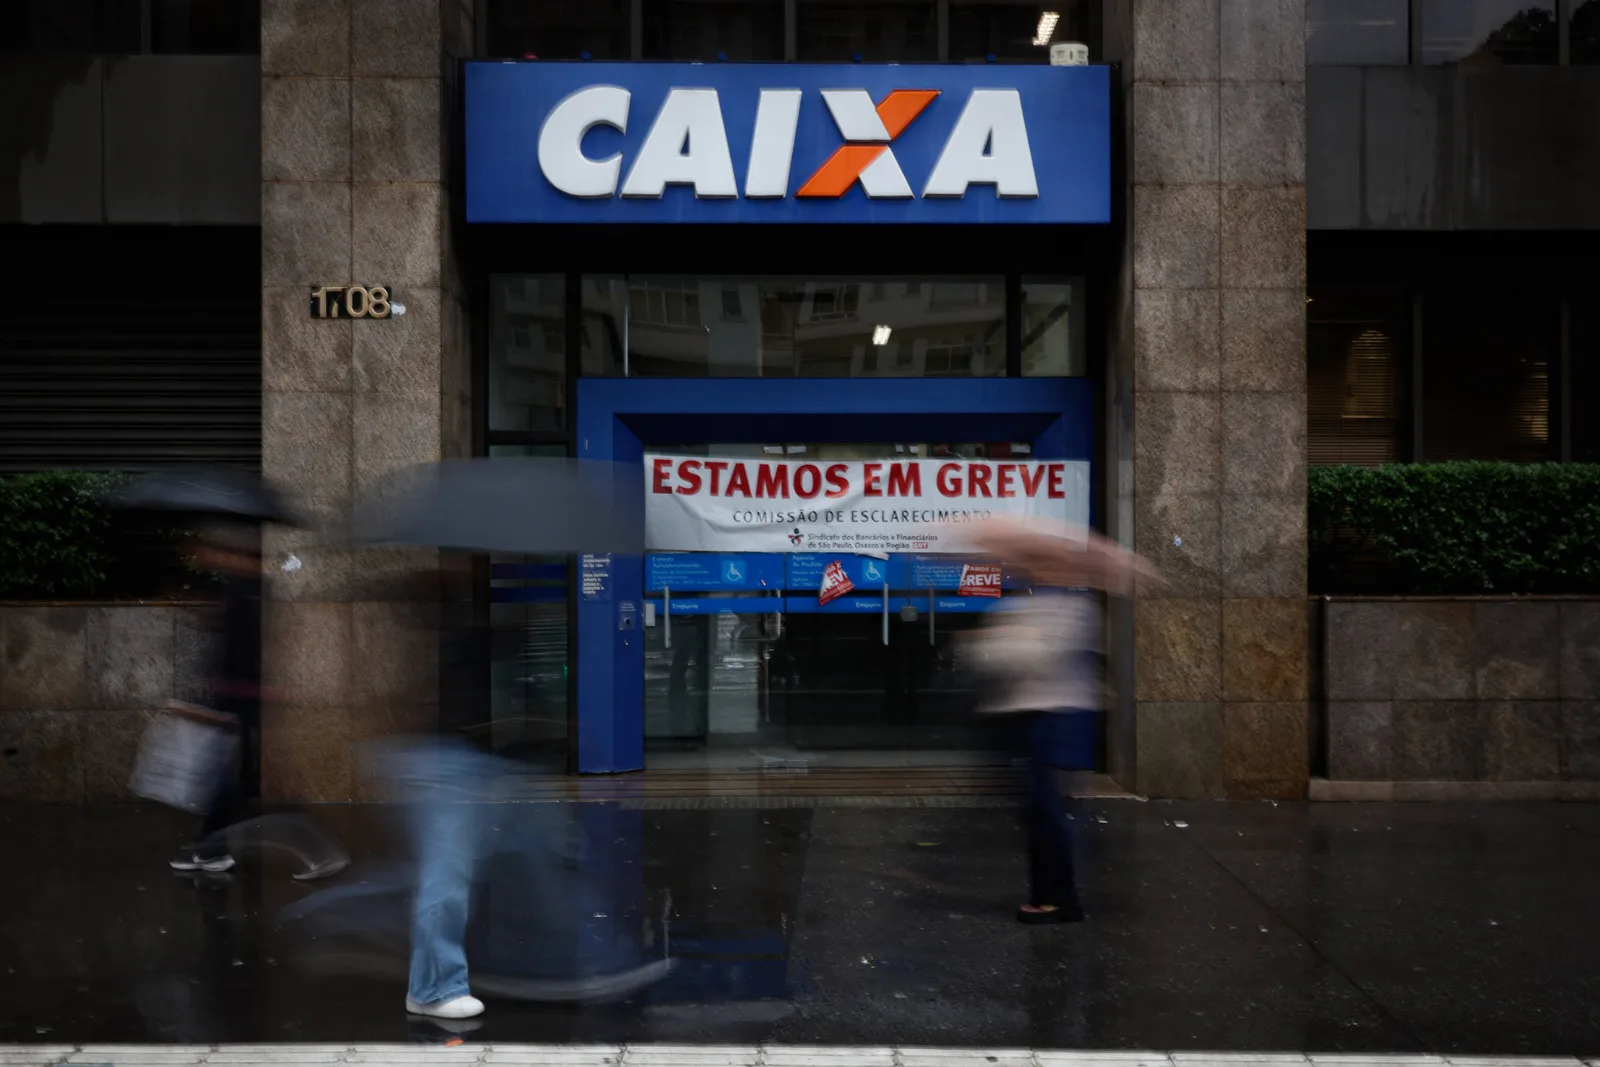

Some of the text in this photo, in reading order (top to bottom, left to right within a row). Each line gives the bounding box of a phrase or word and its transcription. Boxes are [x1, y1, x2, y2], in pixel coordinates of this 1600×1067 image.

[536, 85, 1039, 199] CAIXA
[311, 285, 392, 320] 1708
[652, 459, 1066, 499] ESTAMOS EM GREVE
[733, 506, 992, 523] COMISSÃO DE ESCLARECIMENTO
[855, 533, 889, 541] Bancários
[896, 533, 938, 541] Financiários
[886, 542, 910, 550] Região
